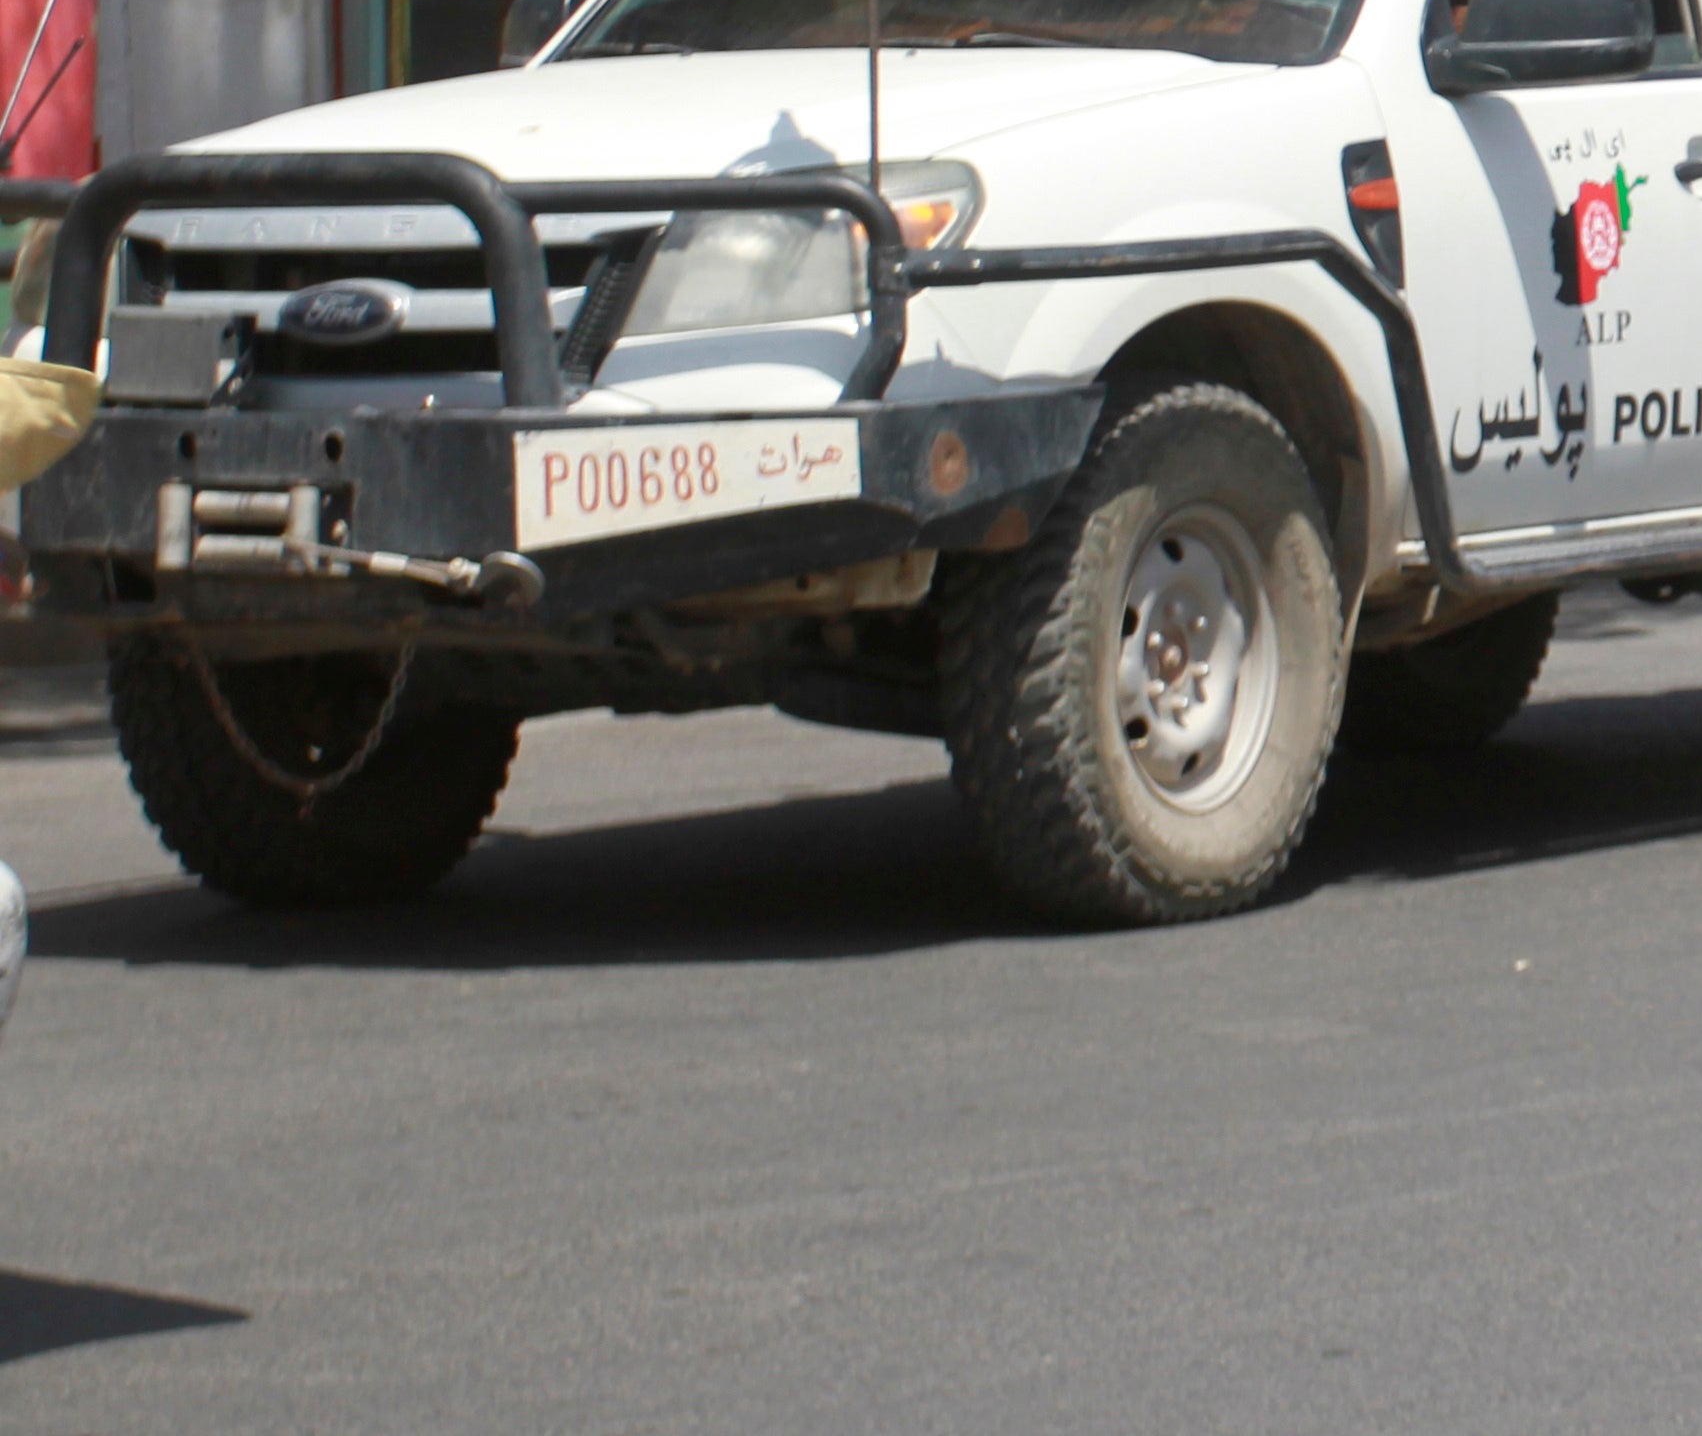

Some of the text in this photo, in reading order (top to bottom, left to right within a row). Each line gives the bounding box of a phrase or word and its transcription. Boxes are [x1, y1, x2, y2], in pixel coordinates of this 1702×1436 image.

[301, 293, 370, 327] Ford
[1575, 310, 1633, 348] ALP
[1449, 343, 1588, 481] پولیس
[541, 441, 721, 518] P00688
